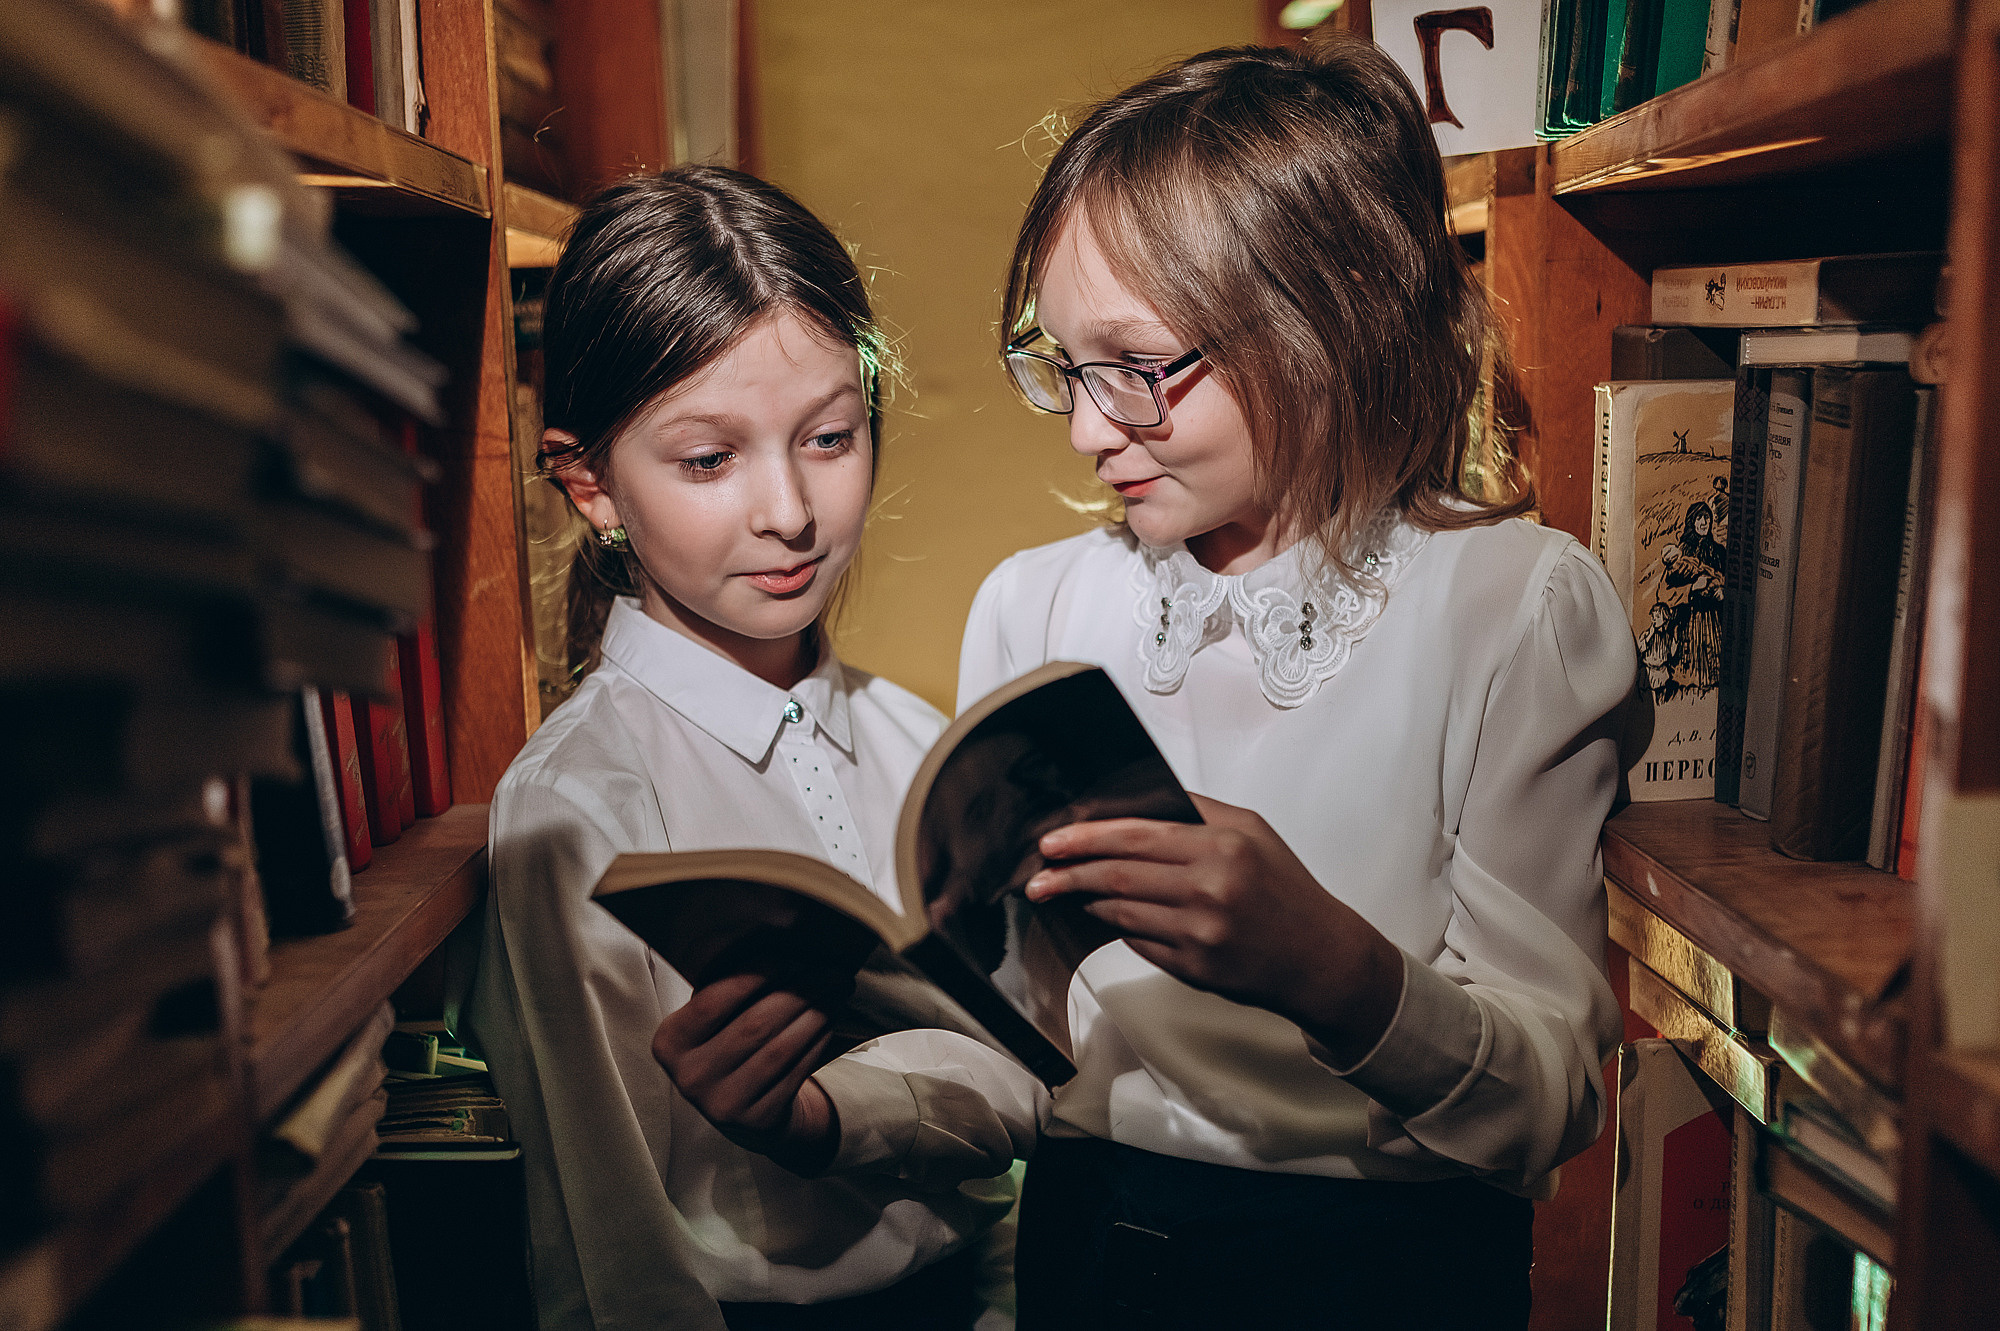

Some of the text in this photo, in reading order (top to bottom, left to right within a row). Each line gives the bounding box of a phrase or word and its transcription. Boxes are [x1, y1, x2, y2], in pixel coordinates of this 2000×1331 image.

[1413, 6, 1494, 130] Г
[1736, 277, 1787, 292] МИХАЙЛОВСКИЙ
[1728, 442, 1746, 588] ИЗБРАННОЕ
[1742, 444, 1760, 595] ИЗБРАННОЕ
